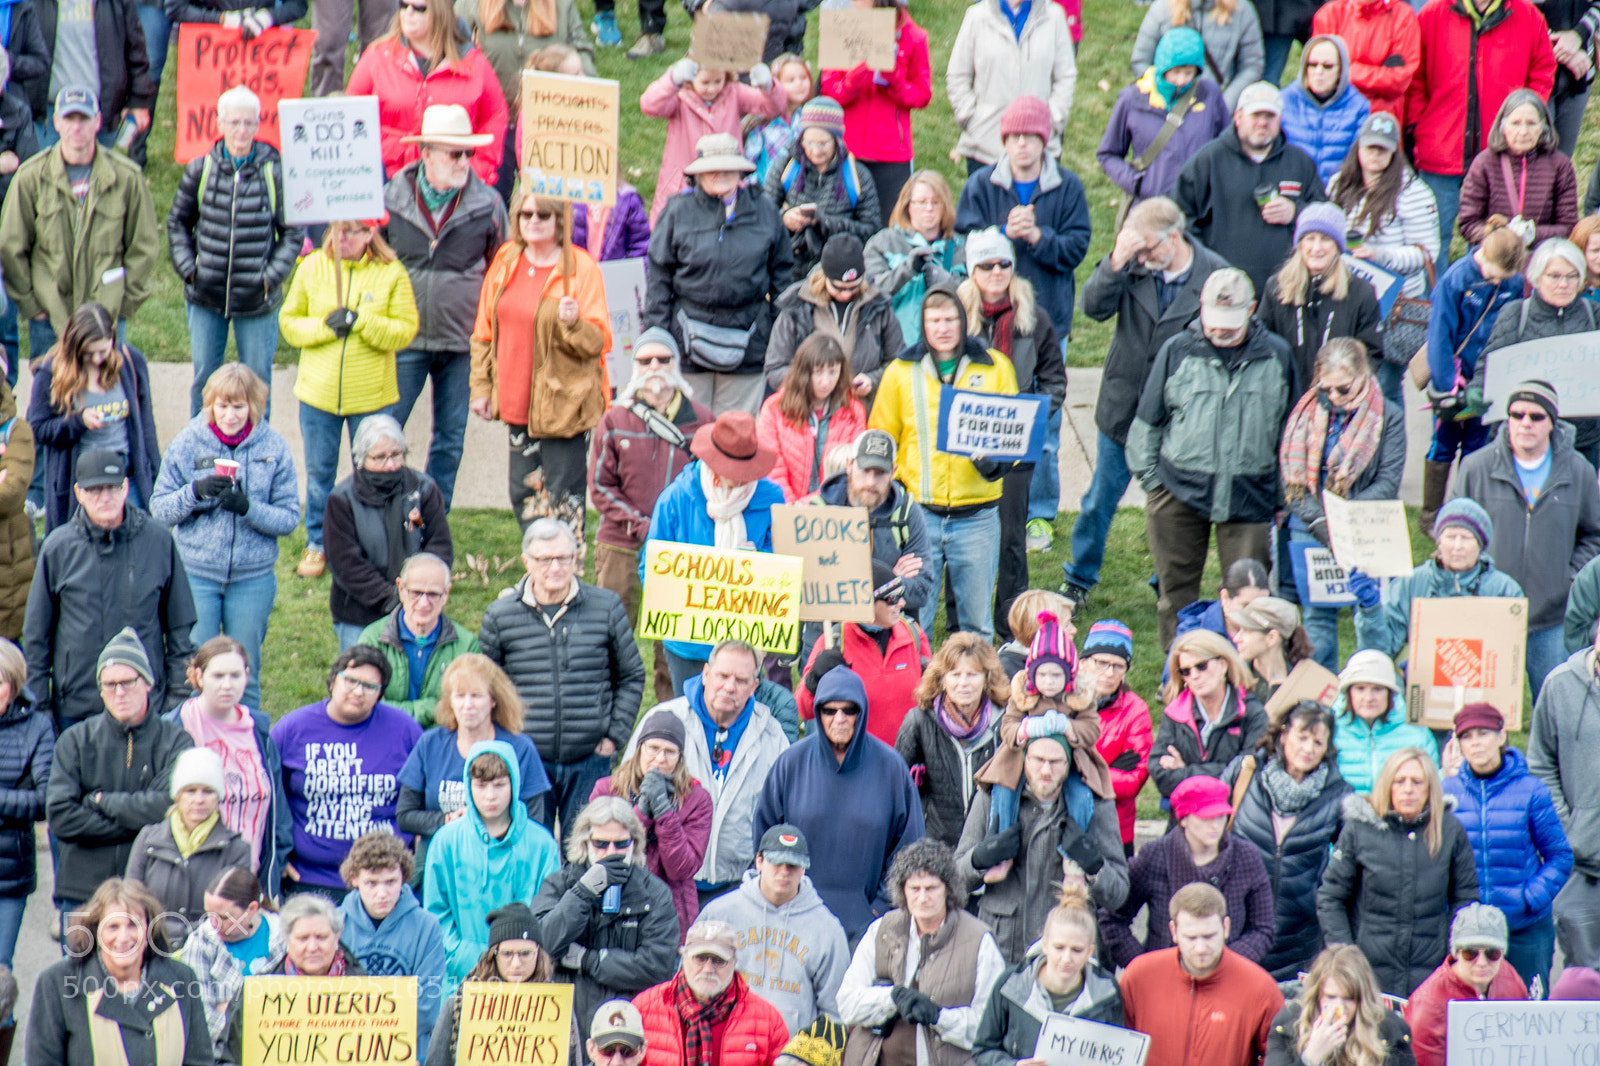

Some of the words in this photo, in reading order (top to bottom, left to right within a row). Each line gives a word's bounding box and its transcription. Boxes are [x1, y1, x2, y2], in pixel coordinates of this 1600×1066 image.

[303, 107, 345, 122] Guns
[537, 115, 603, 134] PRAYERS
[315, 122, 345, 142] DO
[528, 141, 610, 176] ACTION
[960, 402, 1018, 420] MARCH
[959, 418, 989, 432] FOR
[992, 420, 1024, 435] OUR
[794, 515, 870, 544] BOOKS
[653, 551, 754, 586] SCHOOLS
[685, 584, 790, 617] LEARNING
[800, 580, 873, 605] ULLETS
[644, 610, 683, 637] NOT
[690, 614, 794, 650] LOCKDOWN
[305, 743, 321, 760] IF
[322, 742, 357, 760] YOU
[304, 758, 363, 776] AREN'T
[304, 774, 396, 794] HORRIFIED
[306, 801, 372, 822] PAYING
[736, 926, 809, 966] CAPITAL
[770, 977, 800, 995] TEAM
[262, 992, 298, 1015] MY
[307, 991, 397, 1015] UTERUS
[470, 992, 561, 1023] THOUGHTS
[272, 1018, 301, 1029] MORE
[307, 1018, 366, 1029] REGULATED
[371, 1017, 400, 1028] THAN
[496, 1024, 527, 1034] AND
[1464, 1010, 1566, 1042] GERMANY
[258, 1033, 328, 1064] YOUR
[336, 1032, 412, 1063] GUNS
[467, 1032, 558, 1065] PRAYERS
[1050, 1033, 1077, 1055] MY
[1465, 1046, 1495, 1066] TO
